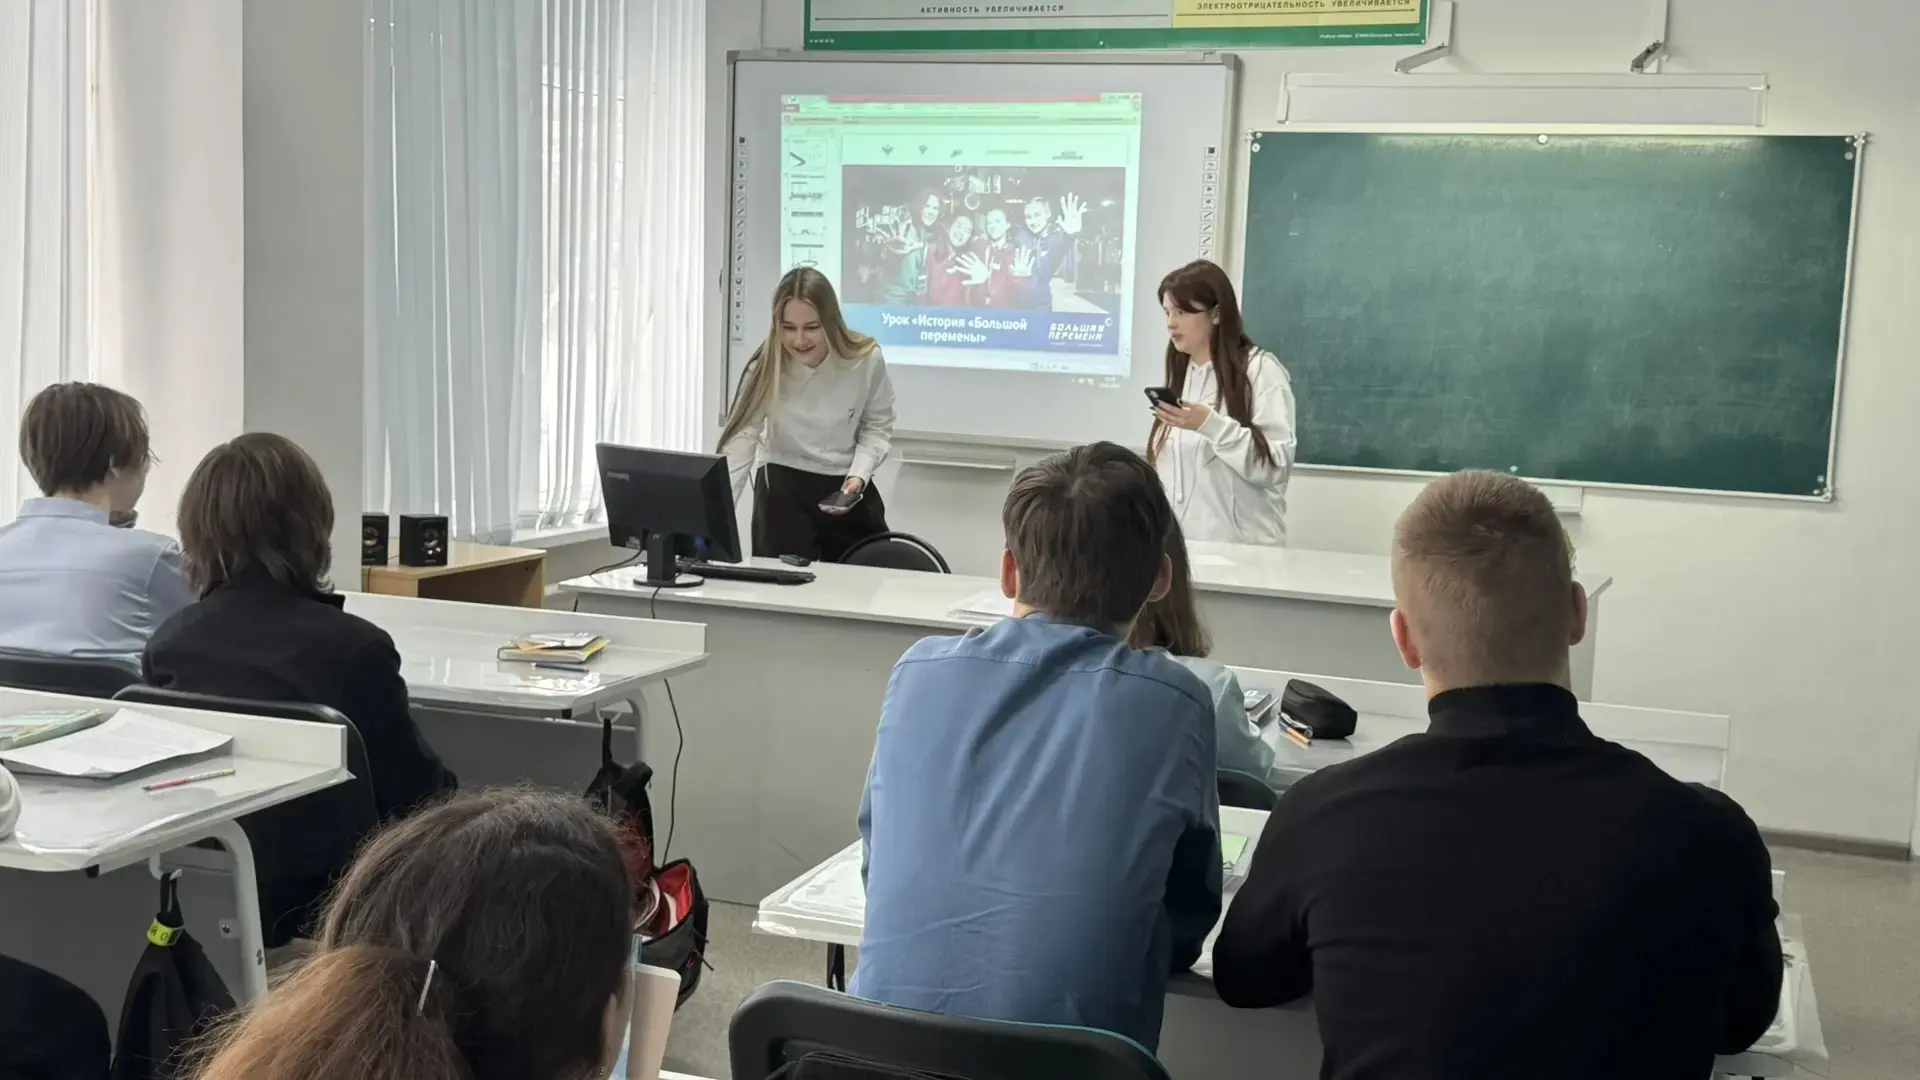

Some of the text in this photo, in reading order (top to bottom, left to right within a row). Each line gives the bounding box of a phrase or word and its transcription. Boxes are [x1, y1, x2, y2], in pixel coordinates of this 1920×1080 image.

[920, 5, 1064, 14] АКТИВНОСТЬ УВЕЛИЧИВАЕТСЯ
[1196, 1, 1326, 10] ЭЛЕКТРООТРИЦАТЕЛЬНОСТЬ
[881, 312, 1030, 331] Урок «История «Большой
[1050, 323, 1105, 333] БОЛЬШАЯ
[920, 331, 987, 343] перемены»
[1049, 331, 1103, 341] ПЕРЕМЕНА
